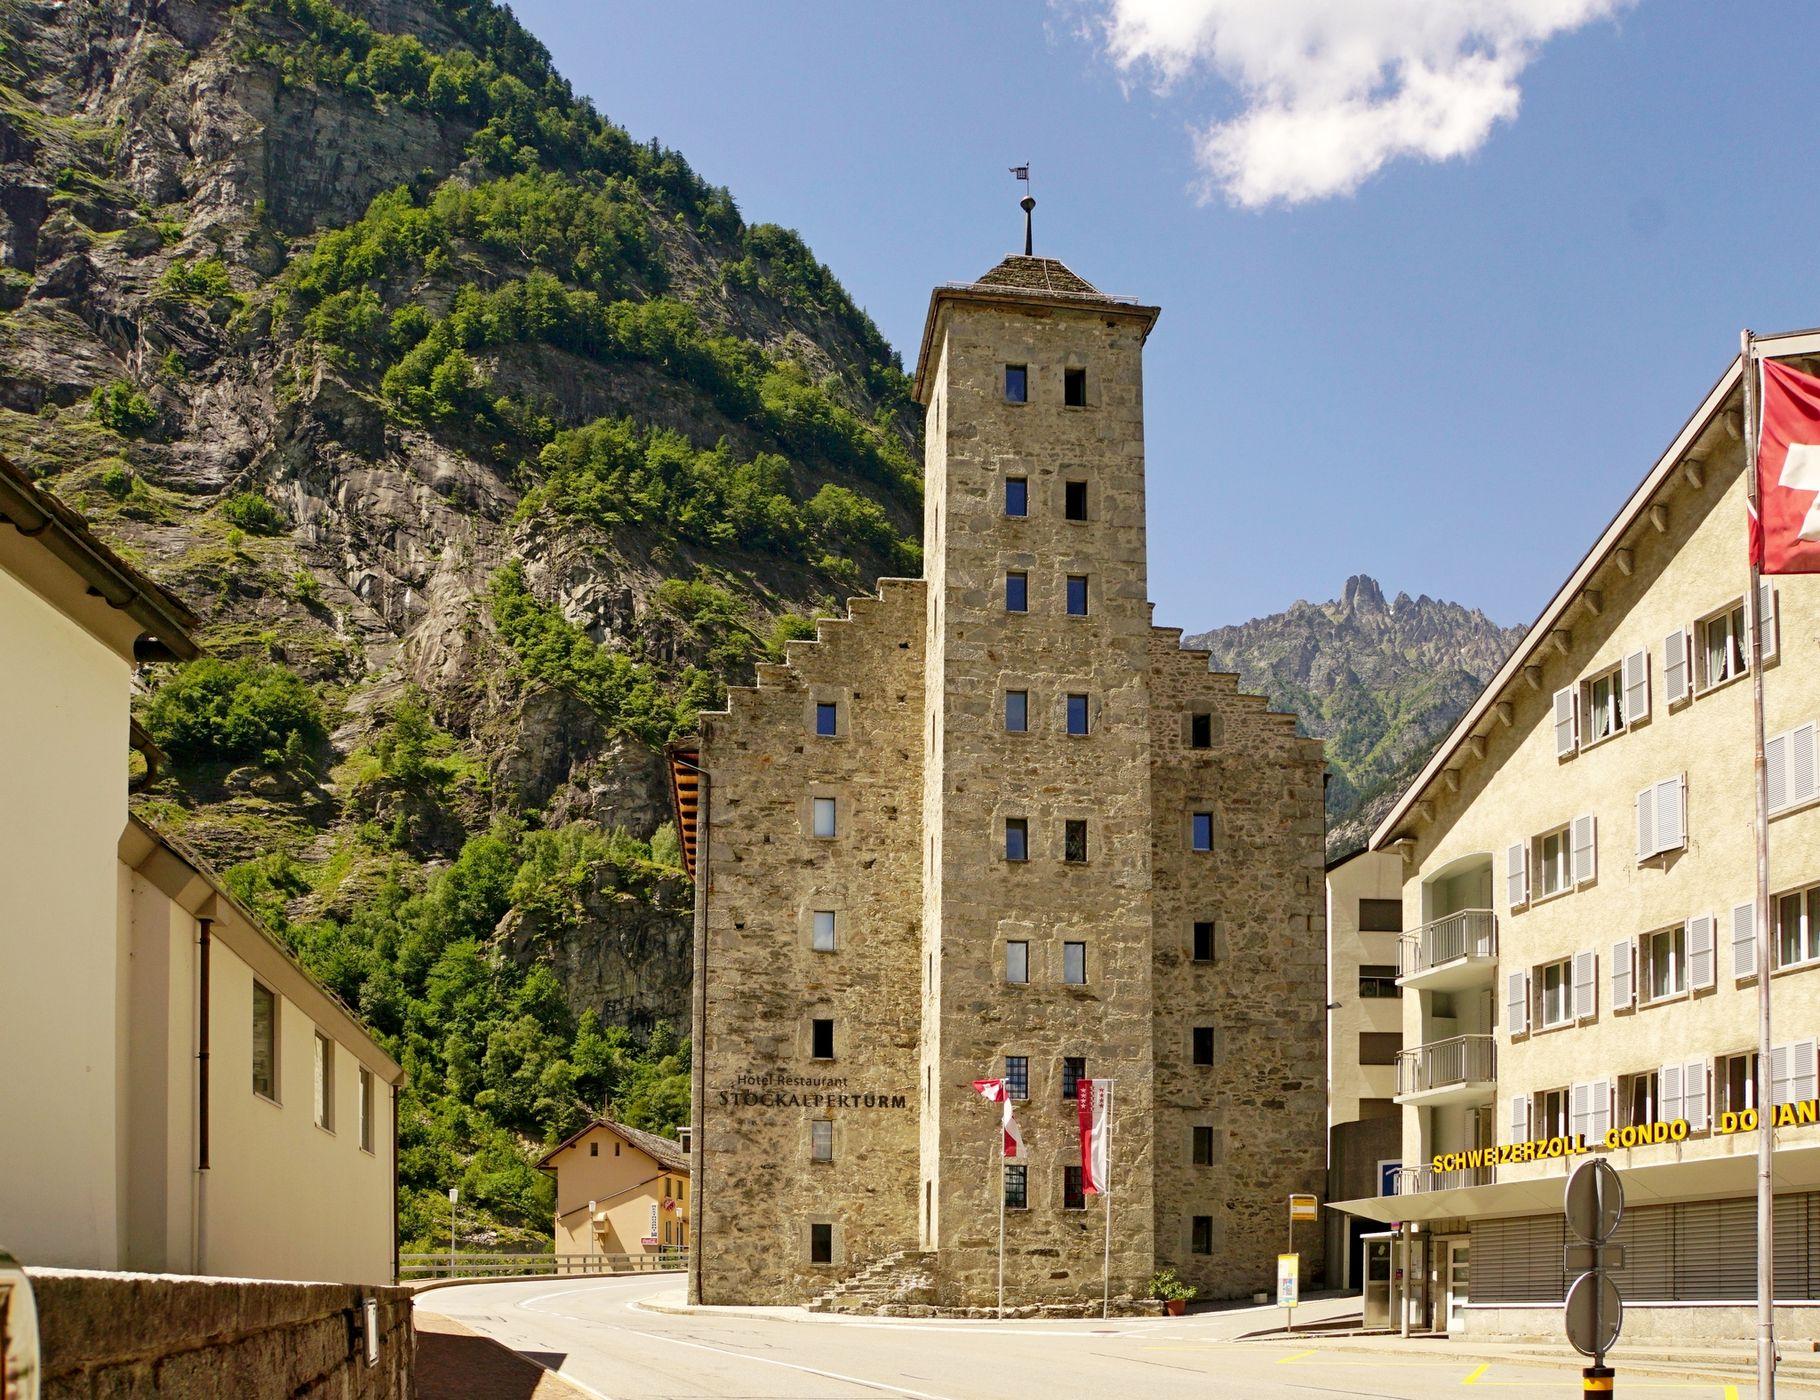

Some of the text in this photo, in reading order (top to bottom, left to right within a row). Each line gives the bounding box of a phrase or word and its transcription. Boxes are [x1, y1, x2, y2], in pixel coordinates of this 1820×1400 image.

[737, 1074, 848, 1087] Hotel Restaurant
[719, 1090, 906, 1109] STOCKALPERTURM
[1433, 1099, 1818, 1173] SCHWEIZERZOLL GONDO DOAN
